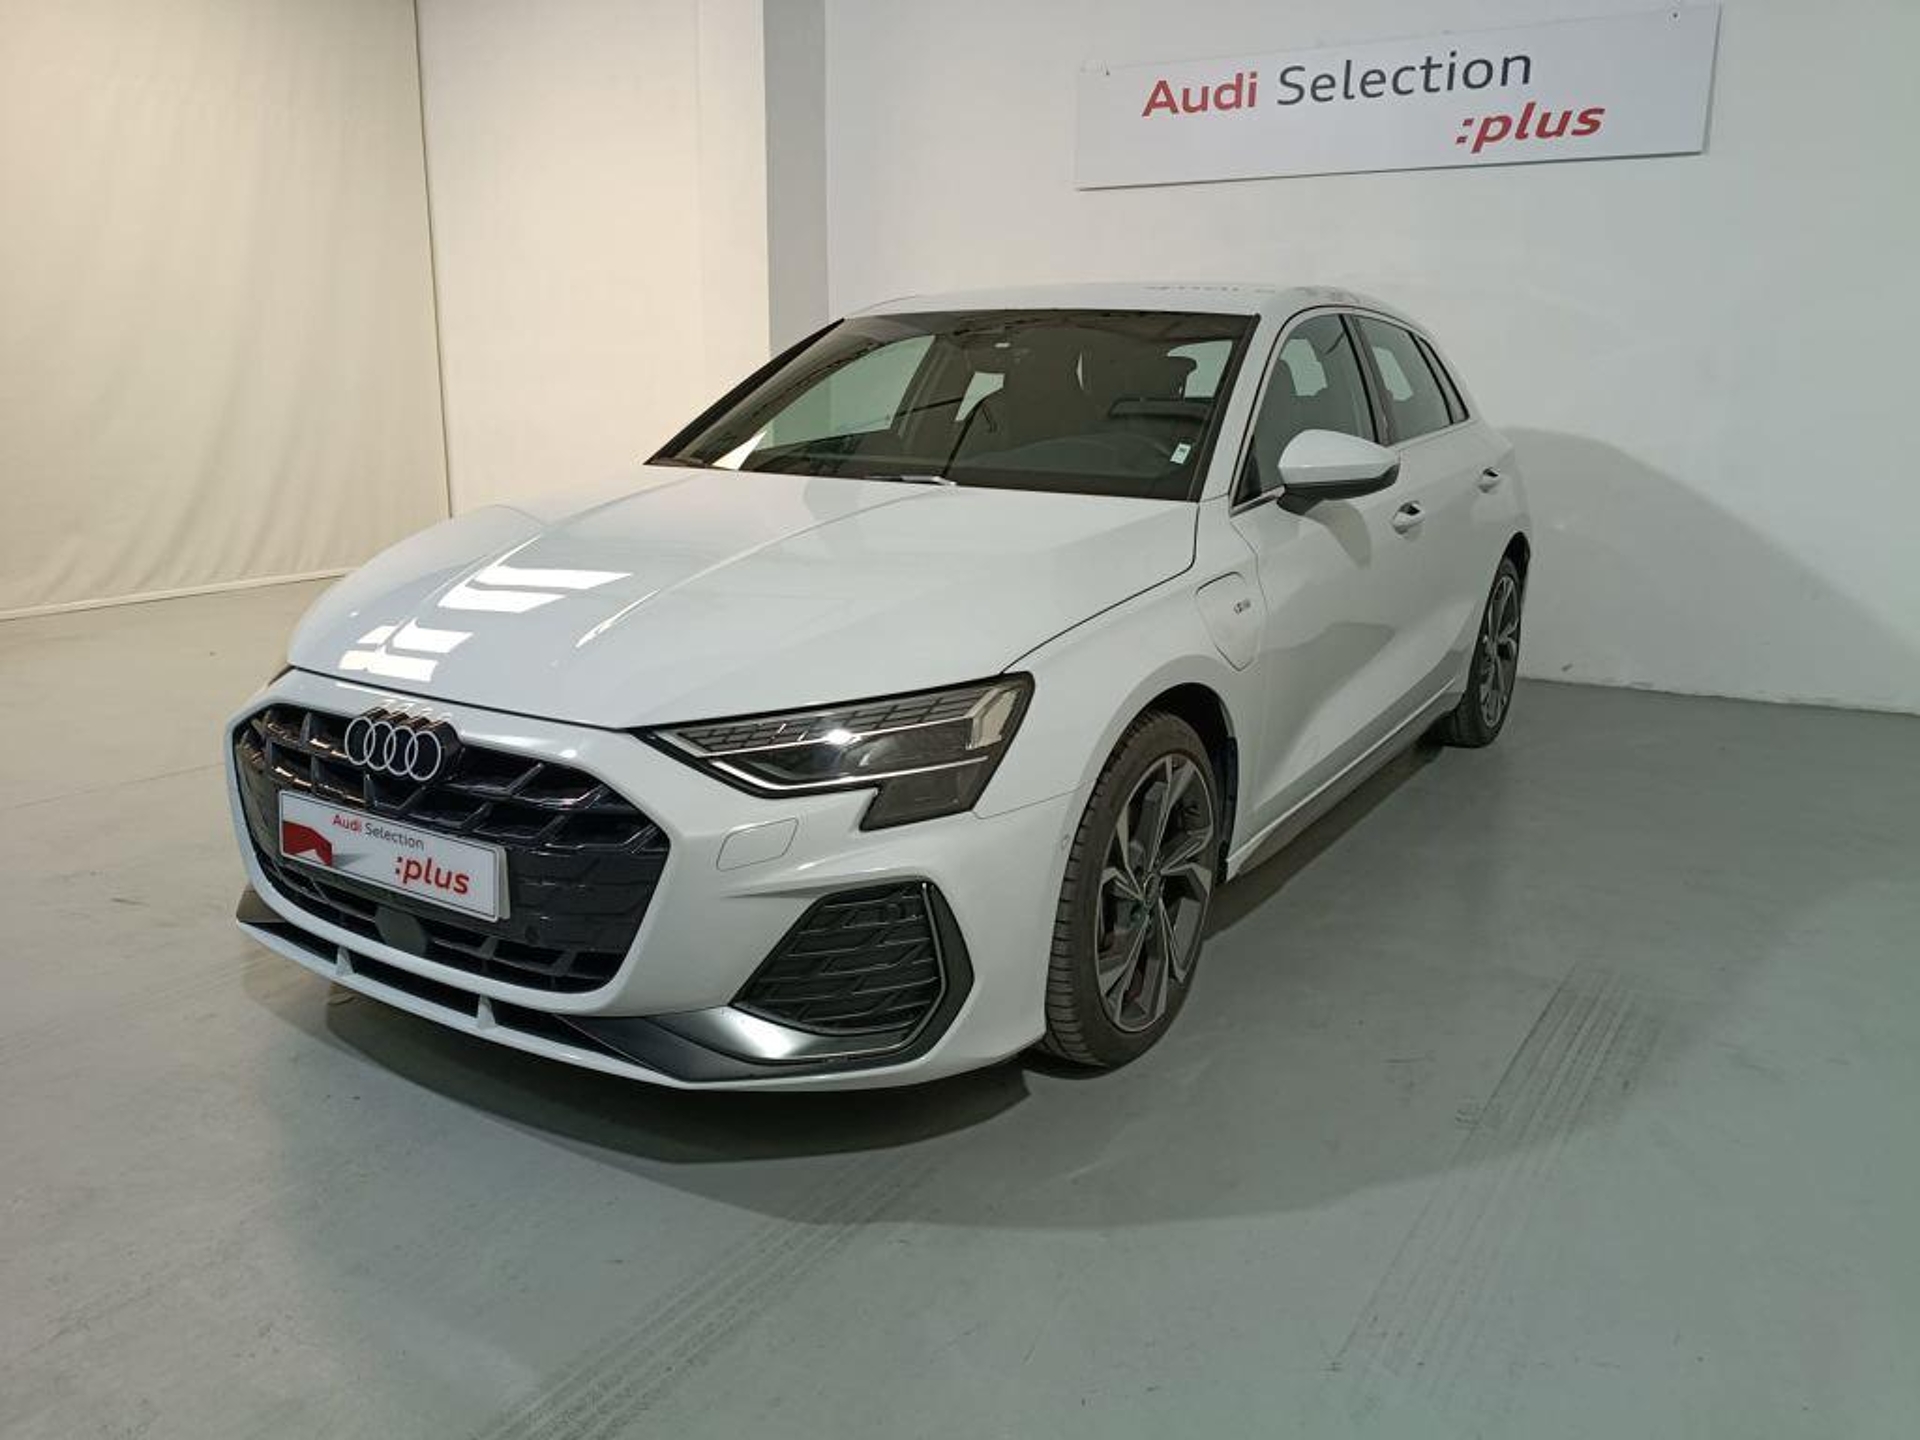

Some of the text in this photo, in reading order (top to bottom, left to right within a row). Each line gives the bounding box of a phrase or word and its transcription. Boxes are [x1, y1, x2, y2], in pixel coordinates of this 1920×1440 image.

[1142, 50, 1532, 118] Audi Selection
[1455, 102, 1606, 154] :plus
[332, 814, 425, 851] Audi Selection
[395, 856, 469, 894] :plus
